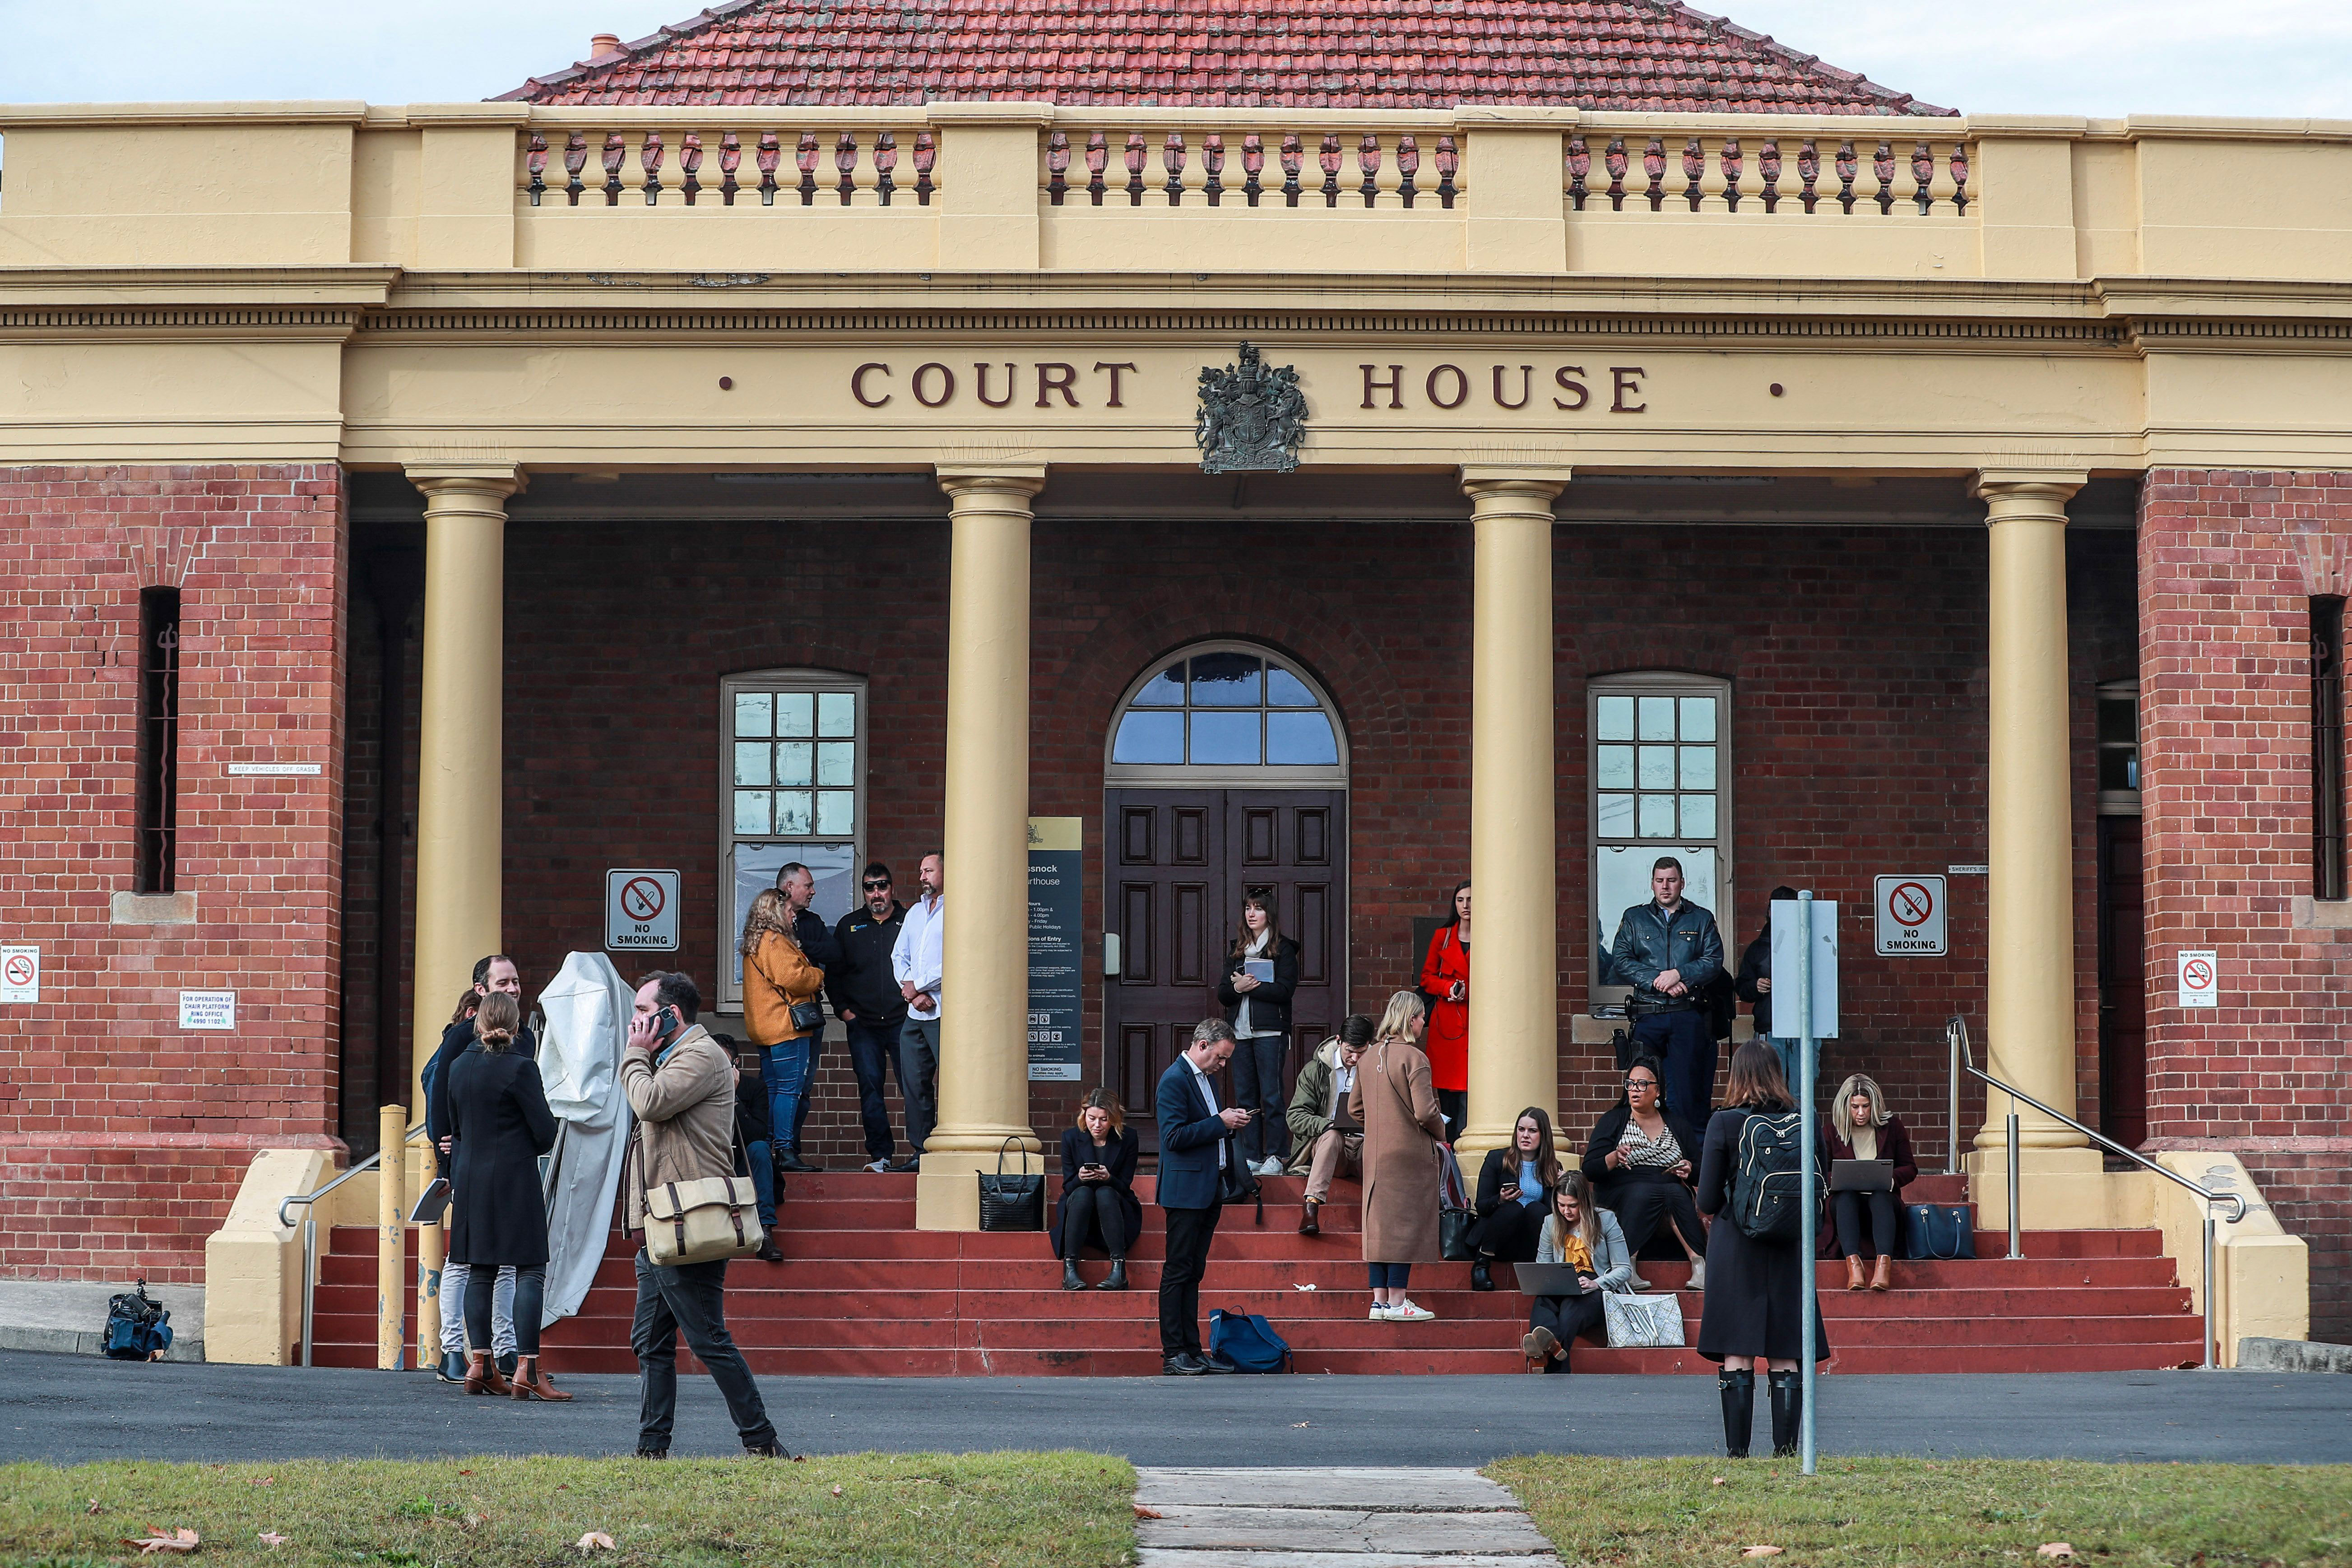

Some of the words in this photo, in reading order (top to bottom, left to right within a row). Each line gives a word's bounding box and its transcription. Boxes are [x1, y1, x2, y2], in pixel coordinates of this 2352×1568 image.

[851, 362, 1137, 407] COURT
[1359, 364, 1646, 412] HOUSE
[635, 924, 650, 932] NO
[1904, 929, 1919, 938] NO
[617, 935, 668, 944] SMOKING
[1887, 941, 1936, 949] SMOKING
